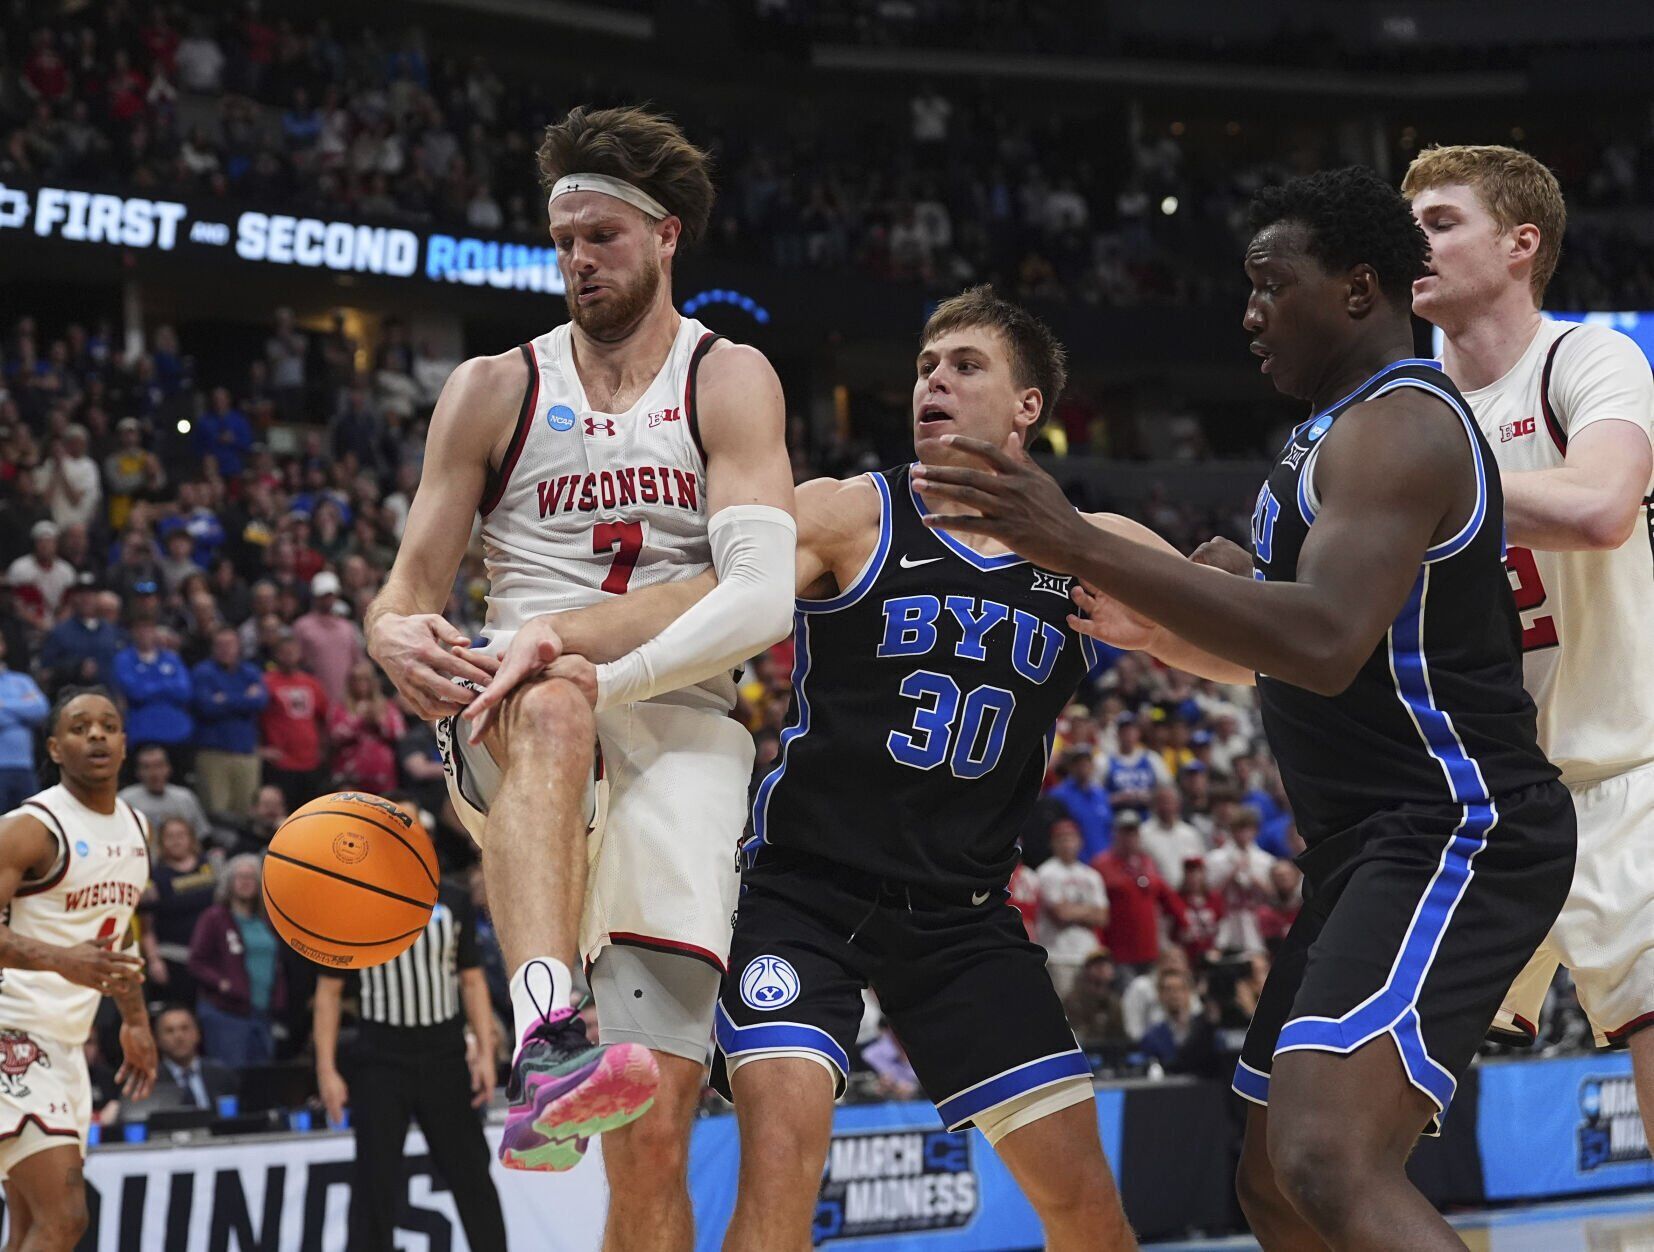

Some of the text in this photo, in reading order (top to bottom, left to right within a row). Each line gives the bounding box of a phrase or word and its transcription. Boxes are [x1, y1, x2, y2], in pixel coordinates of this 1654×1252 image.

[34, 187, 187, 251] FIRST
[189, 220, 230, 246] AND
[235, 211, 419, 277] SECOND
[549, 414, 573, 426] NCAA
[592, 521, 643, 595] 7
[876, 594, 1066, 685] BYU
[886, 669, 1017, 780] 30
[759, 986, 780, 1001] Y
[830, 1133, 924, 1182] MARCH
[845, 1171, 976, 1224] MADNESS
